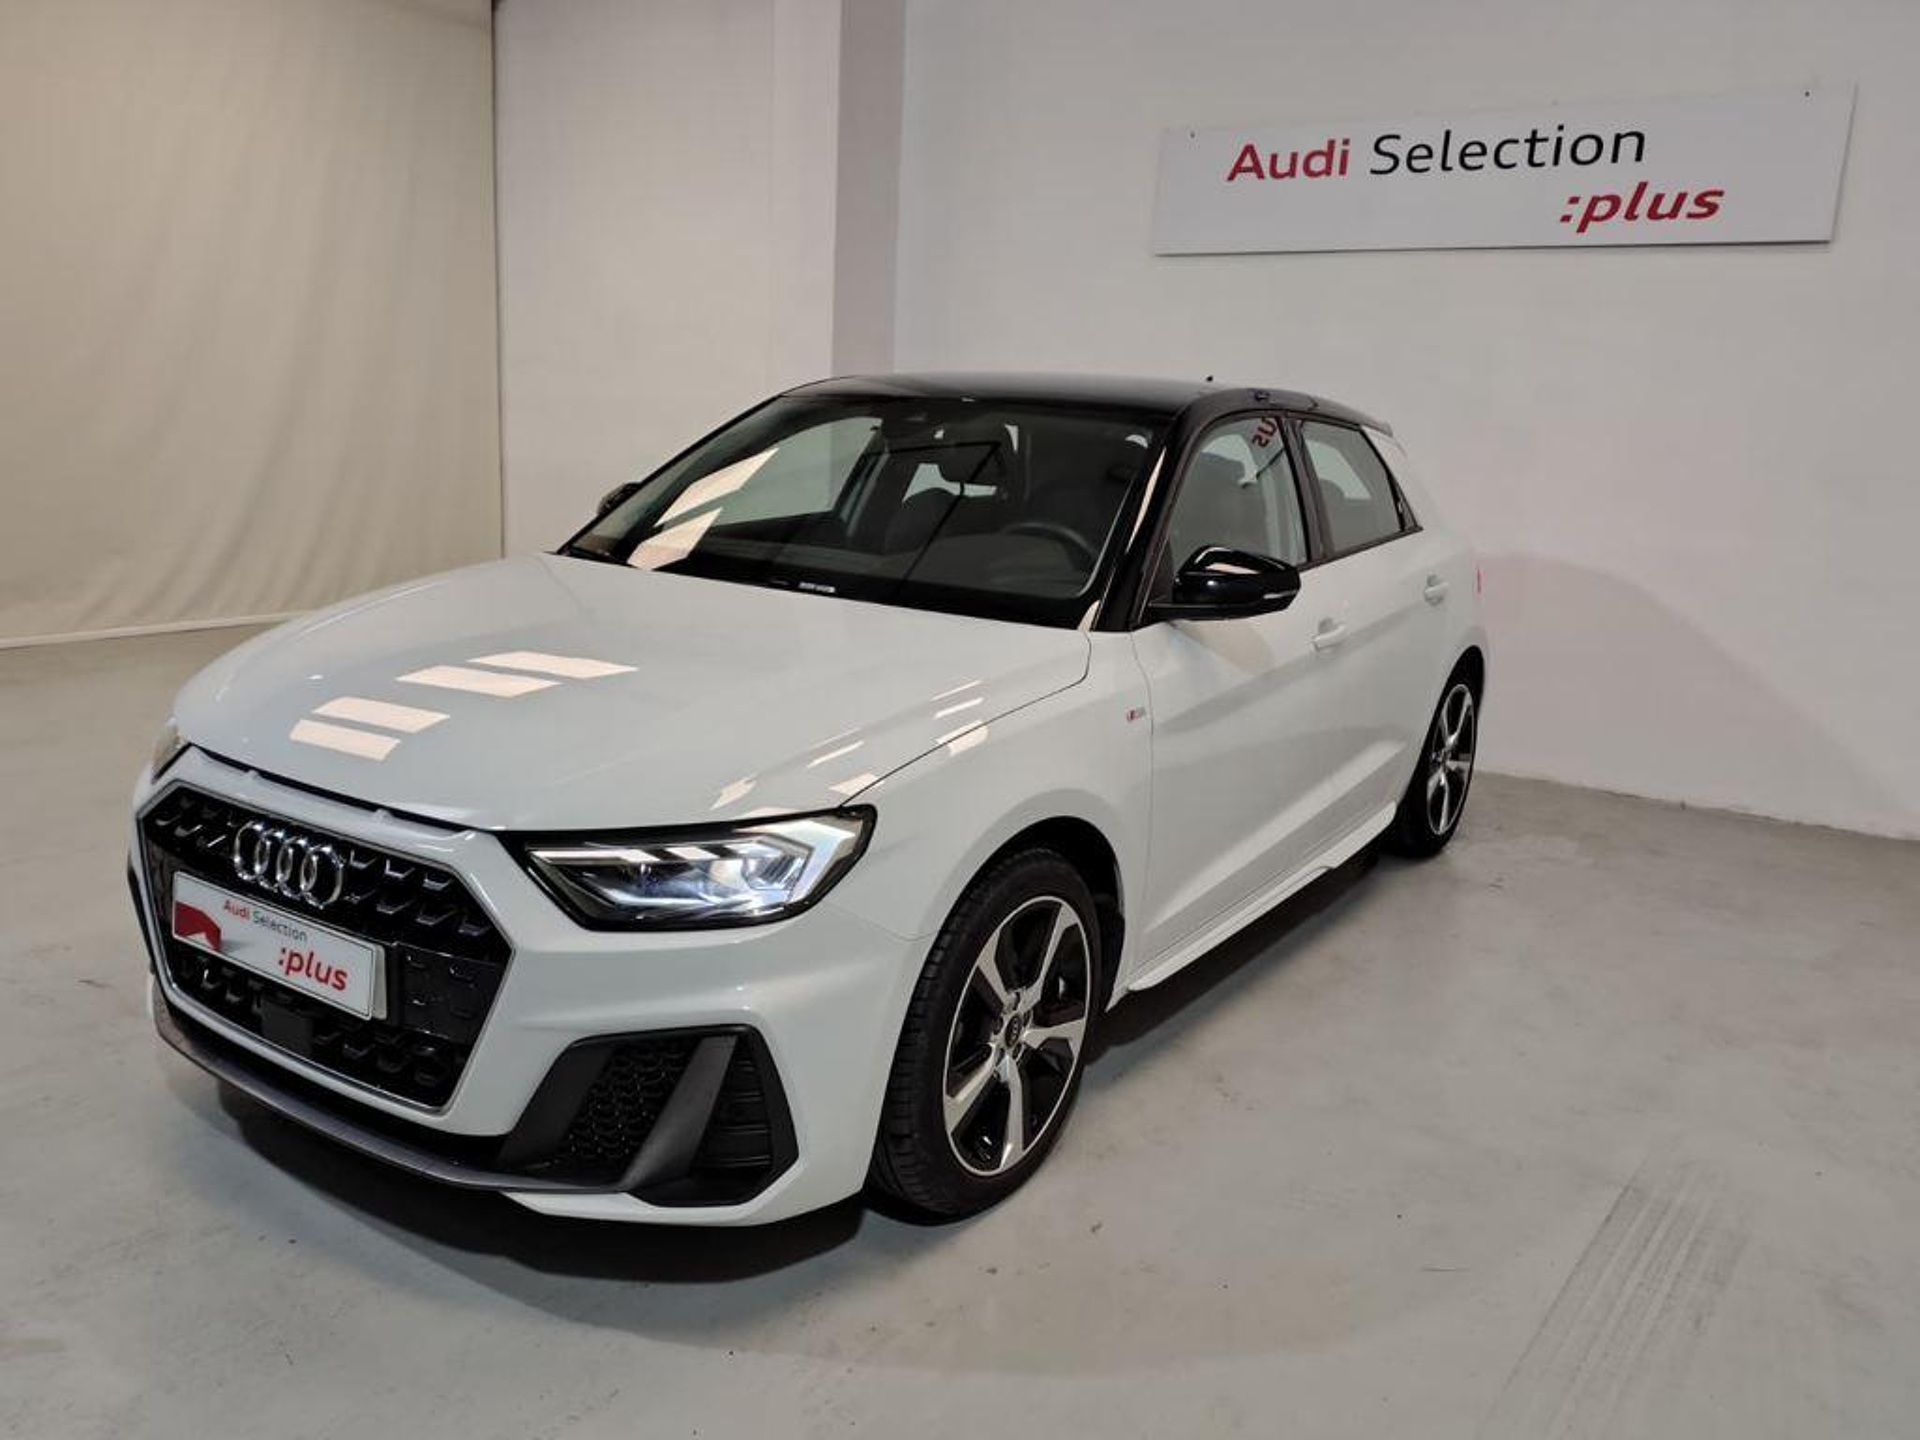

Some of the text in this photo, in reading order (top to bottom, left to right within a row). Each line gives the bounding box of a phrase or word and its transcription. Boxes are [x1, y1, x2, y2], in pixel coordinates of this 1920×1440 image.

[1226, 124, 1647, 182] Audi Selection
[1559, 181, 1725, 233] :plus
[223, 899, 308, 942] Audi Selection
[278, 947, 348, 991] :plus
